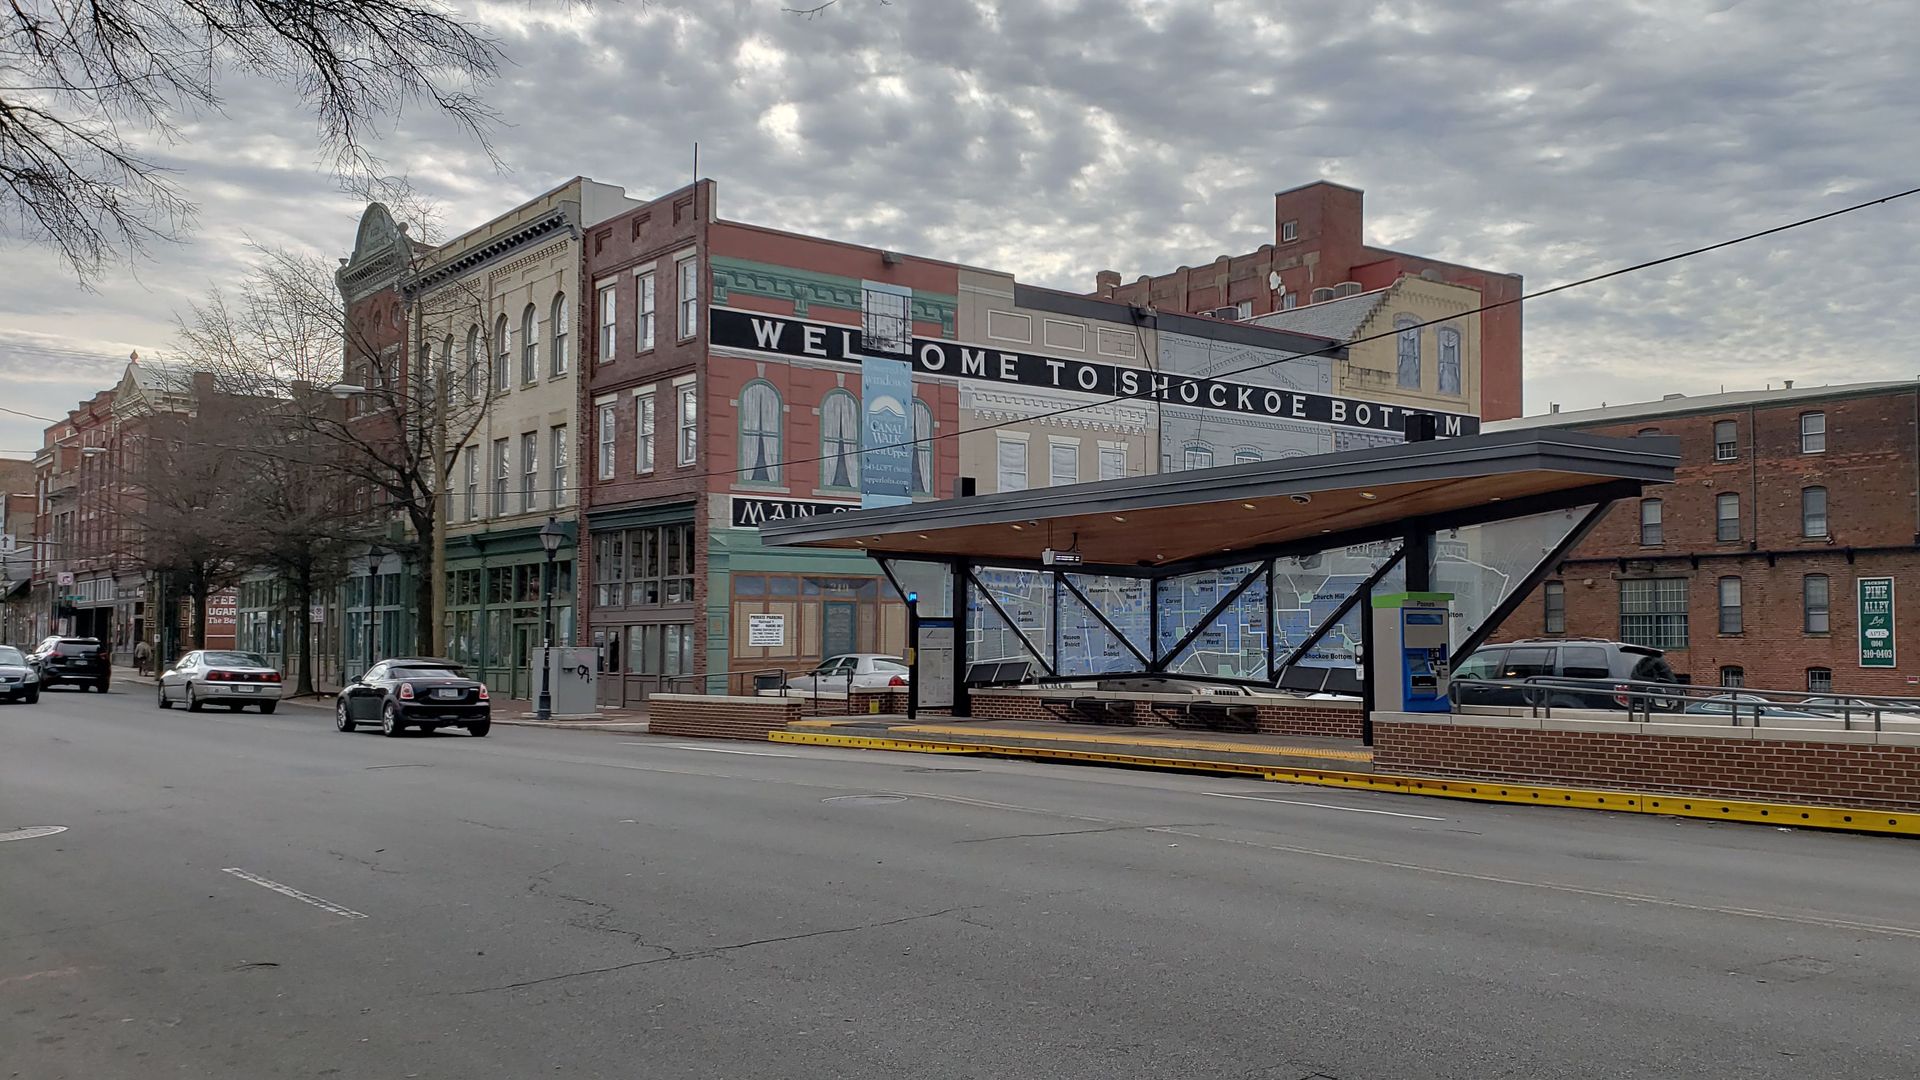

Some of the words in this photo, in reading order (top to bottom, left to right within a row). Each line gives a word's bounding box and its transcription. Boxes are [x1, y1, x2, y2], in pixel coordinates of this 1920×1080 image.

[751, 318, 1019, 381] WELOME
[1046, 359, 1098, 391] TO
[1121, 370, 1307, 417] SHOCKOE
[1331, 400, 1461, 437] BOTM
[871, 420, 904, 434] CANAL
[872, 432, 902, 444] WALK
[739, 501, 816, 524] MAIN
[208, 595, 236, 605] FEE
[1864, 601, 1889, 614] ALLEY
[1304, 652, 1329, 660] Shockoe
[1863, 649, 1892, 659] 310-0403
